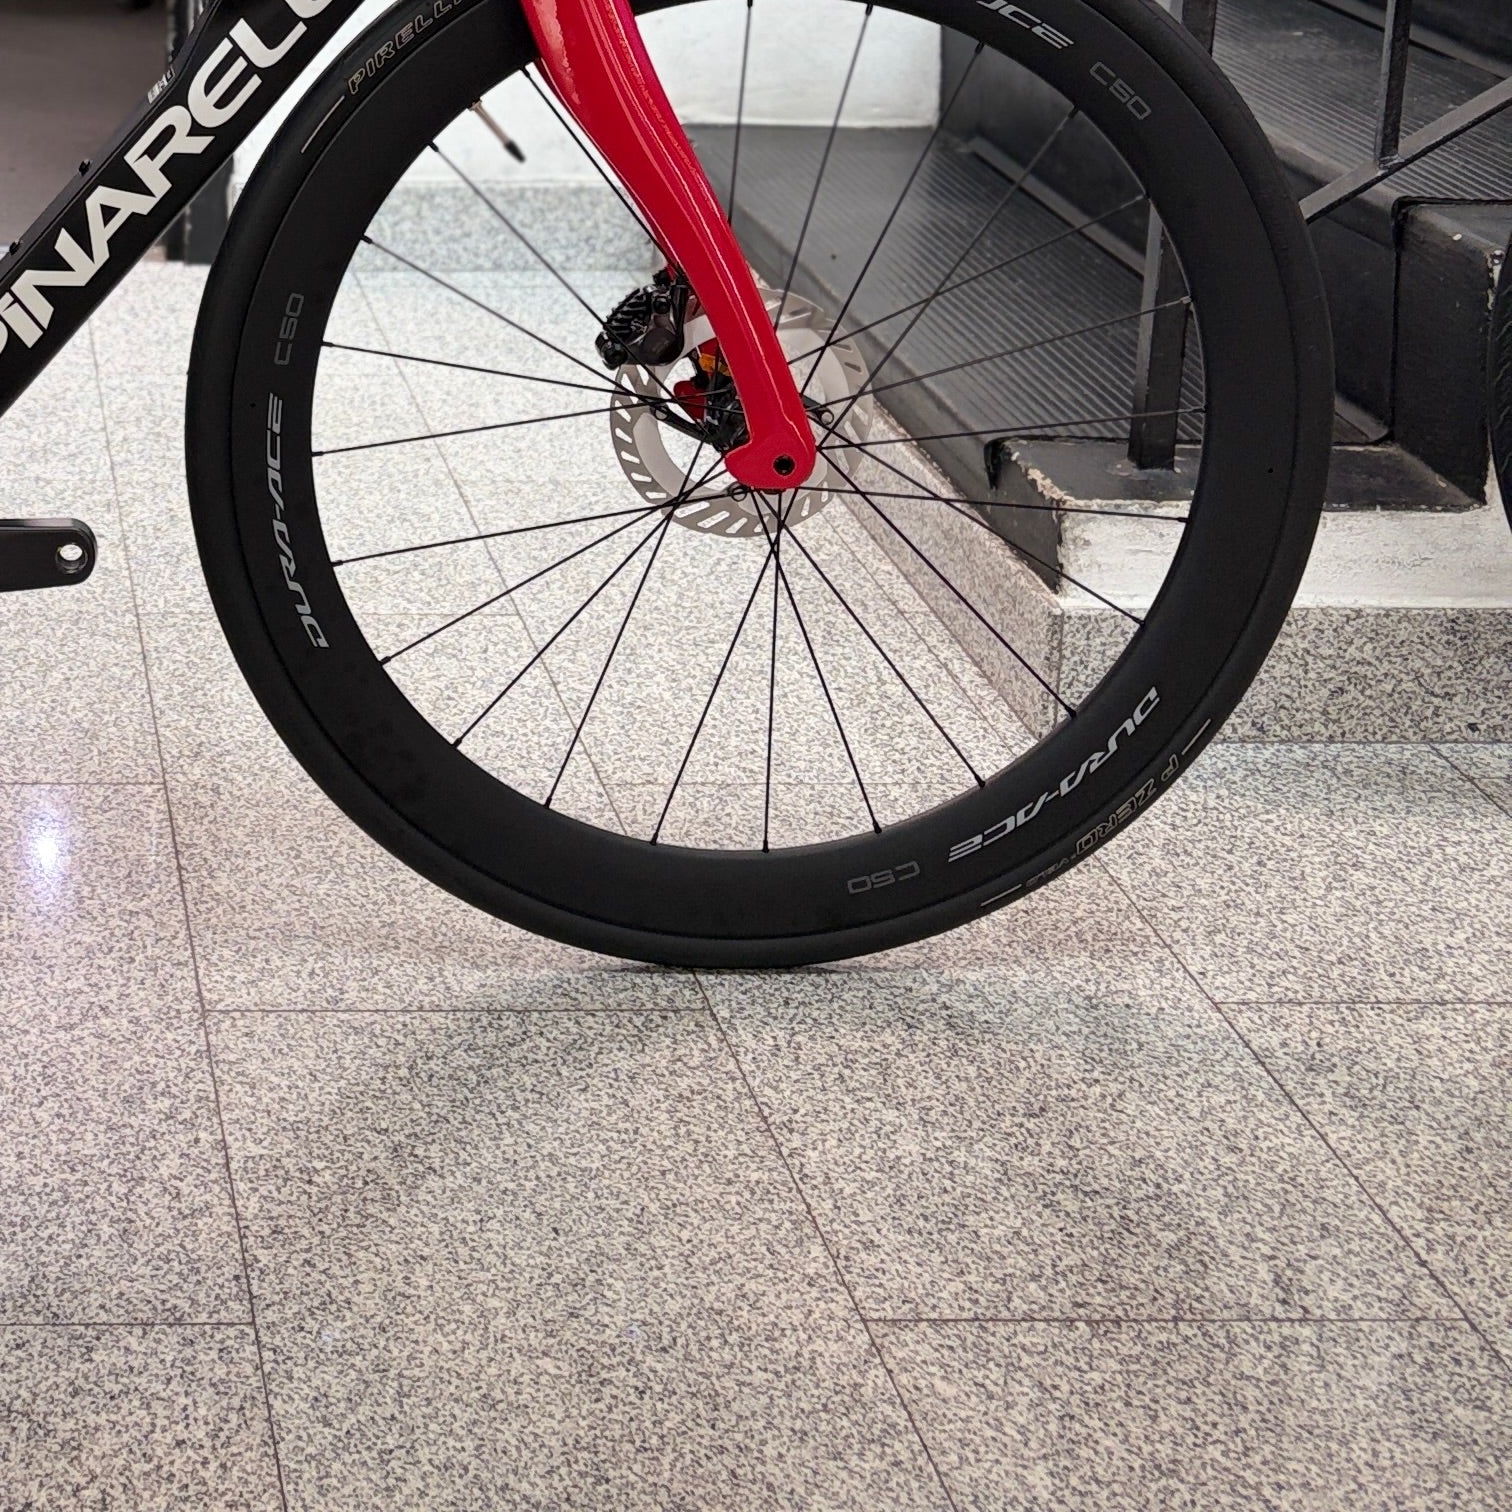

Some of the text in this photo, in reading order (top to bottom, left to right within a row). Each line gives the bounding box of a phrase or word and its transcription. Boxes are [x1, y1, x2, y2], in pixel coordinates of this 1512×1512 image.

[1090, 61, 1152, 121] C50
[266, 293, 330, 649] DURA-ACE C50
[847, 686, 1161, 894] DURA-ACE C50
[1076, 778, 1156, 855] ZERO
